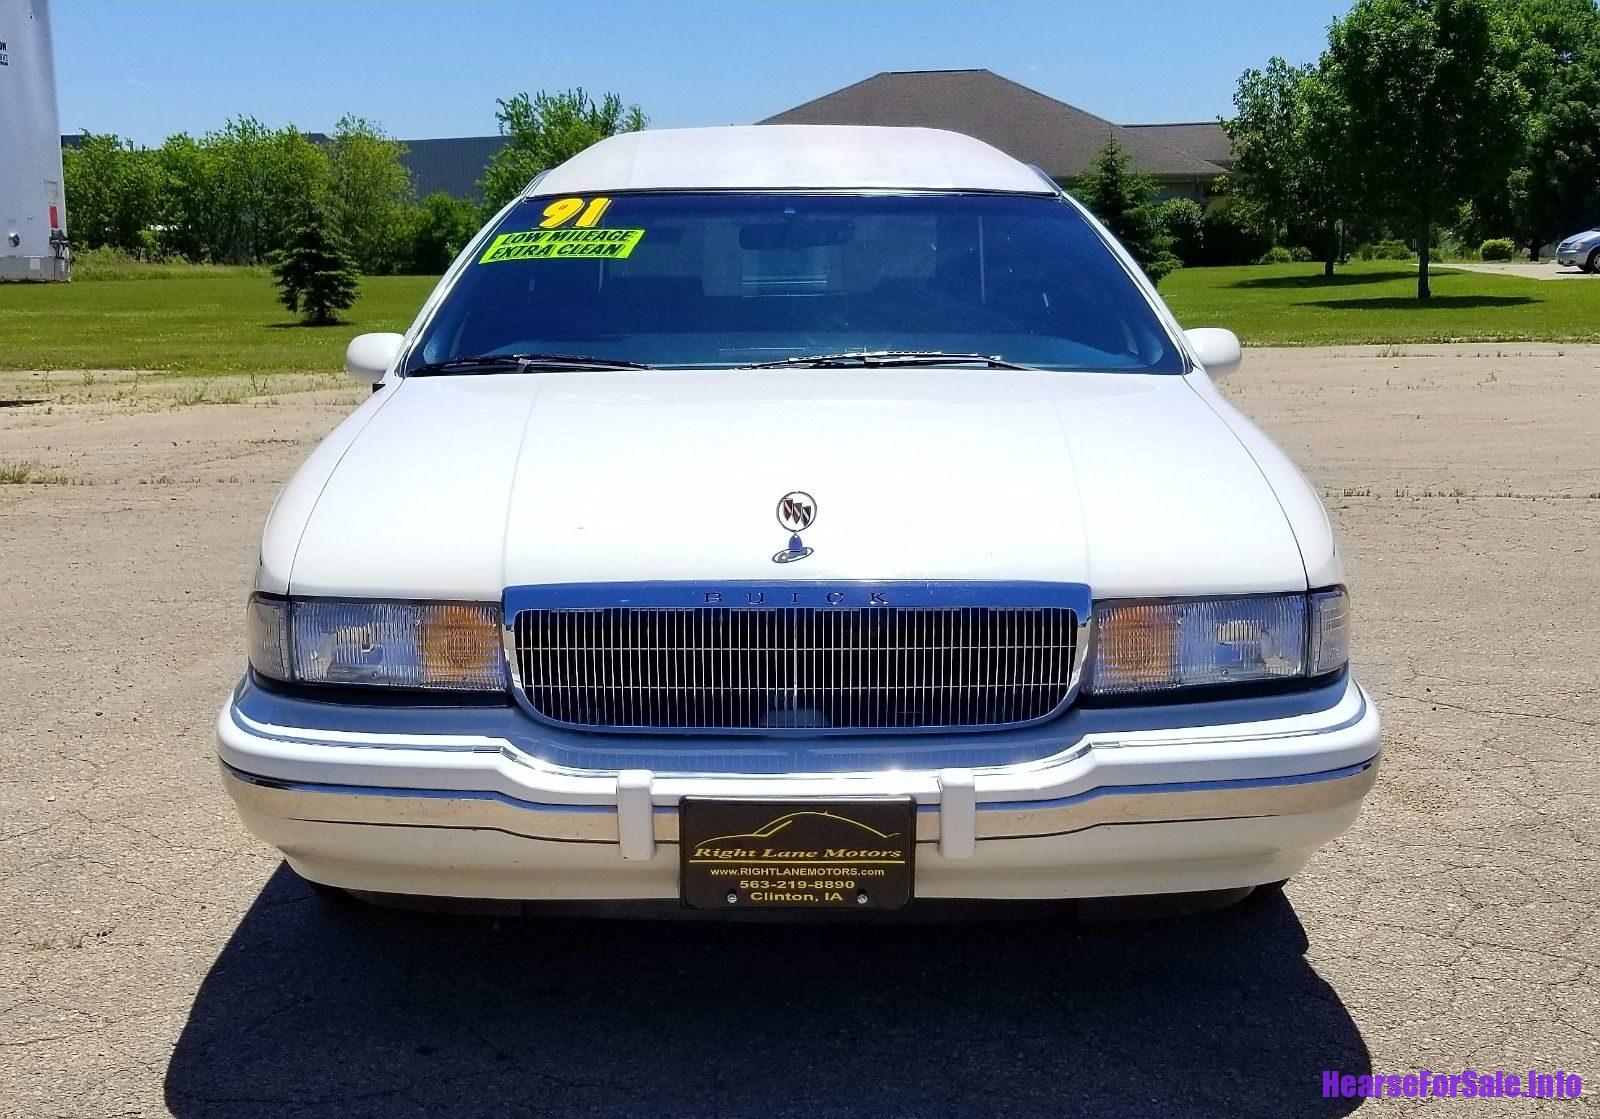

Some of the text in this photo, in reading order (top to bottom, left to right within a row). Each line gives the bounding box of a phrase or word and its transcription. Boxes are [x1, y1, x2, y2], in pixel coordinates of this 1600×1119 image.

[539, 197, 612, 228] 91
[502, 230, 635, 245] LOW MILEAGE
[489, 243, 624, 259] EXTRA CLEAN
[703, 592, 889, 605] BUICK
[693, 848, 902, 858] Right Lane Motors
[710, 867, 885, 876] www.RIGHTLANEMOTORS.com
[739, 880, 855, 889] 563-219-8890
[750, 892, 843, 902] Clinton, IA
